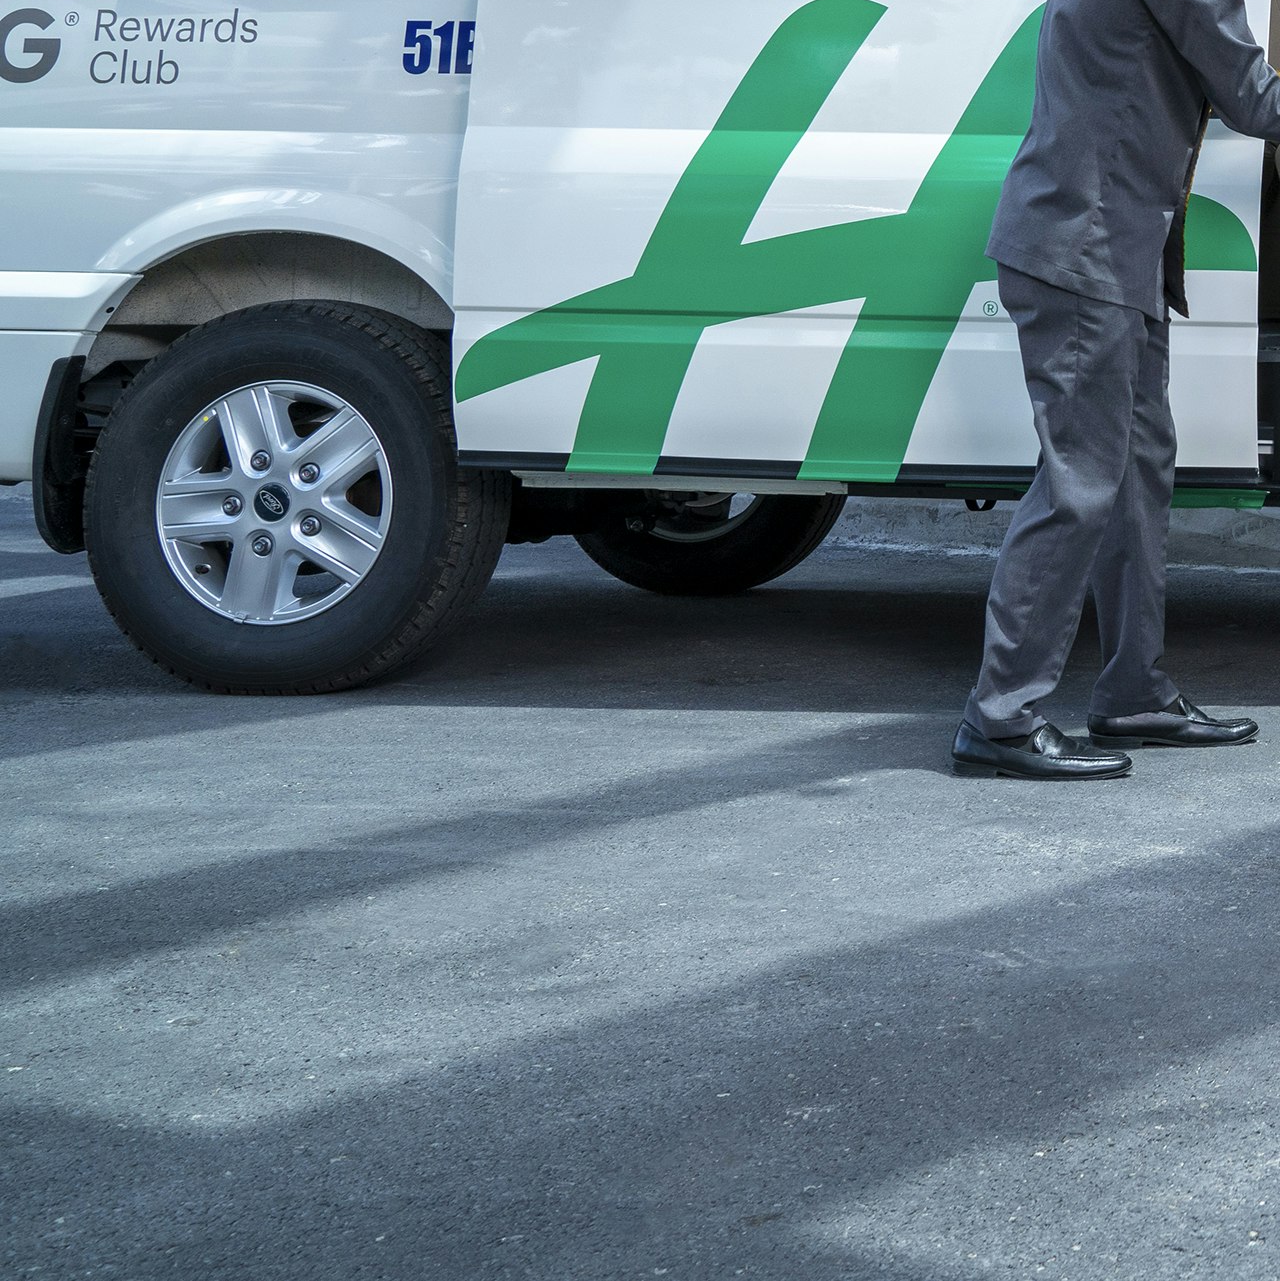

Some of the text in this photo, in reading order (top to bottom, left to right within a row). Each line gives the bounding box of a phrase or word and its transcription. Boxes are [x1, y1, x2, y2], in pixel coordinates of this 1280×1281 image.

[94, 8, 259, 44] Rewards
[402, 20, 476, 75] 51B
[90, 49, 180, 85] Club
